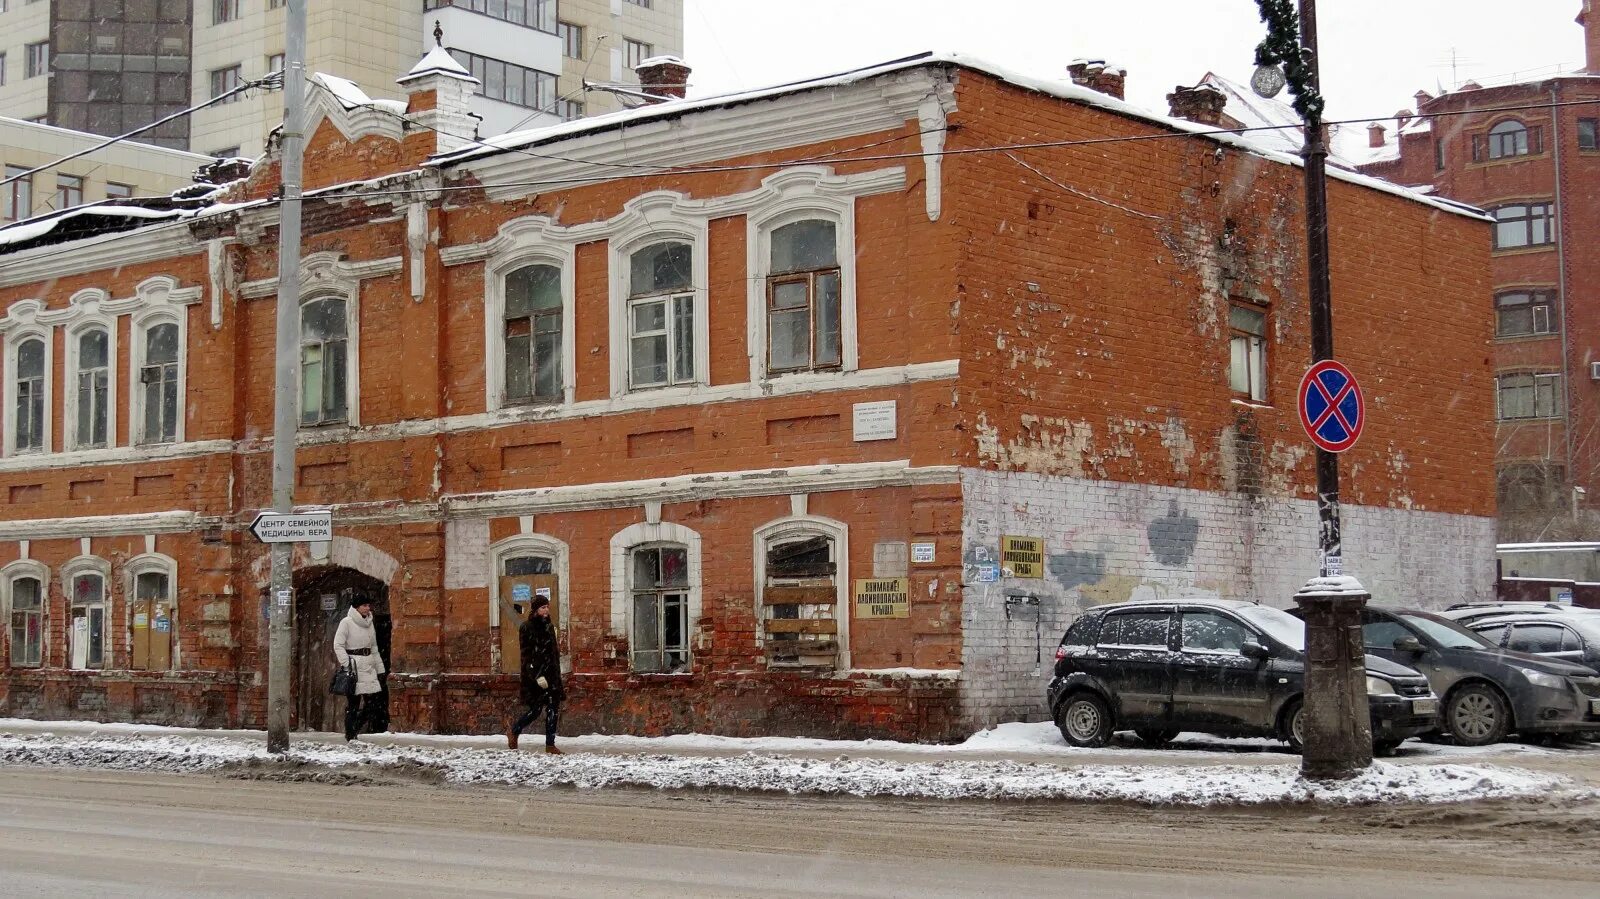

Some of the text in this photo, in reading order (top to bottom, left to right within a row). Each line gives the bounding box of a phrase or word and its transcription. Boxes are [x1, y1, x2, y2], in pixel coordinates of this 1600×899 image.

[260, 518, 329, 528] ЦЕНТР СЕМЕЙНОЙ
[261, 529, 305, 537] МЕДИЦИНЫ
[865, 581, 900, 592] ВНИМАНИЕ!
[871, 604, 894, 615] КРЫША
